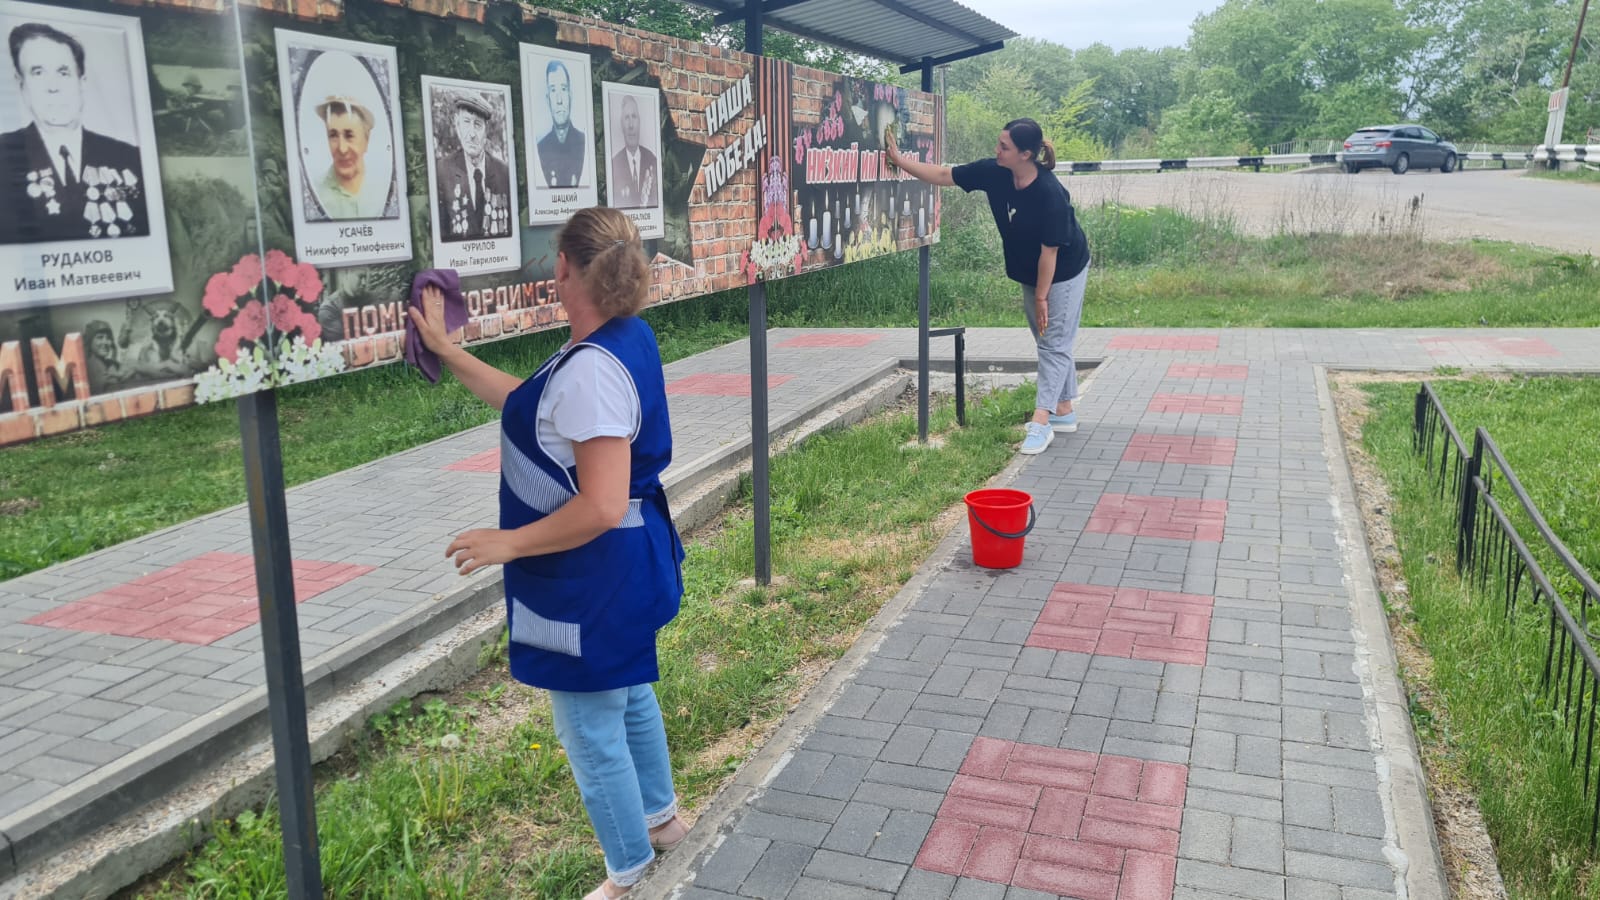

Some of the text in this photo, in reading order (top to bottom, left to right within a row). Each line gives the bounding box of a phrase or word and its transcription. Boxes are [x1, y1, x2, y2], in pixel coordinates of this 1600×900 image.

[705, 72, 752, 137] НАША
[704, 114, 767, 198] ПОБЕДА!
[806, 142, 858, 184] НИЗКИЙ
[861, 149, 878, 182] ИМ
[338, 223, 373, 238] УСАЧЁВ
[305, 241, 405, 257] Никифор Тимофеевич
[462, 241, 496, 252] ЧУРИЛОВ
[41, 249, 113, 268] РУДАКОВ
[449, 255, 509, 268] Иван Гаврилович
[14, 269, 142, 291] Иван Матвеевич
[463, 279, 559, 318] ОРДИМСЯ
